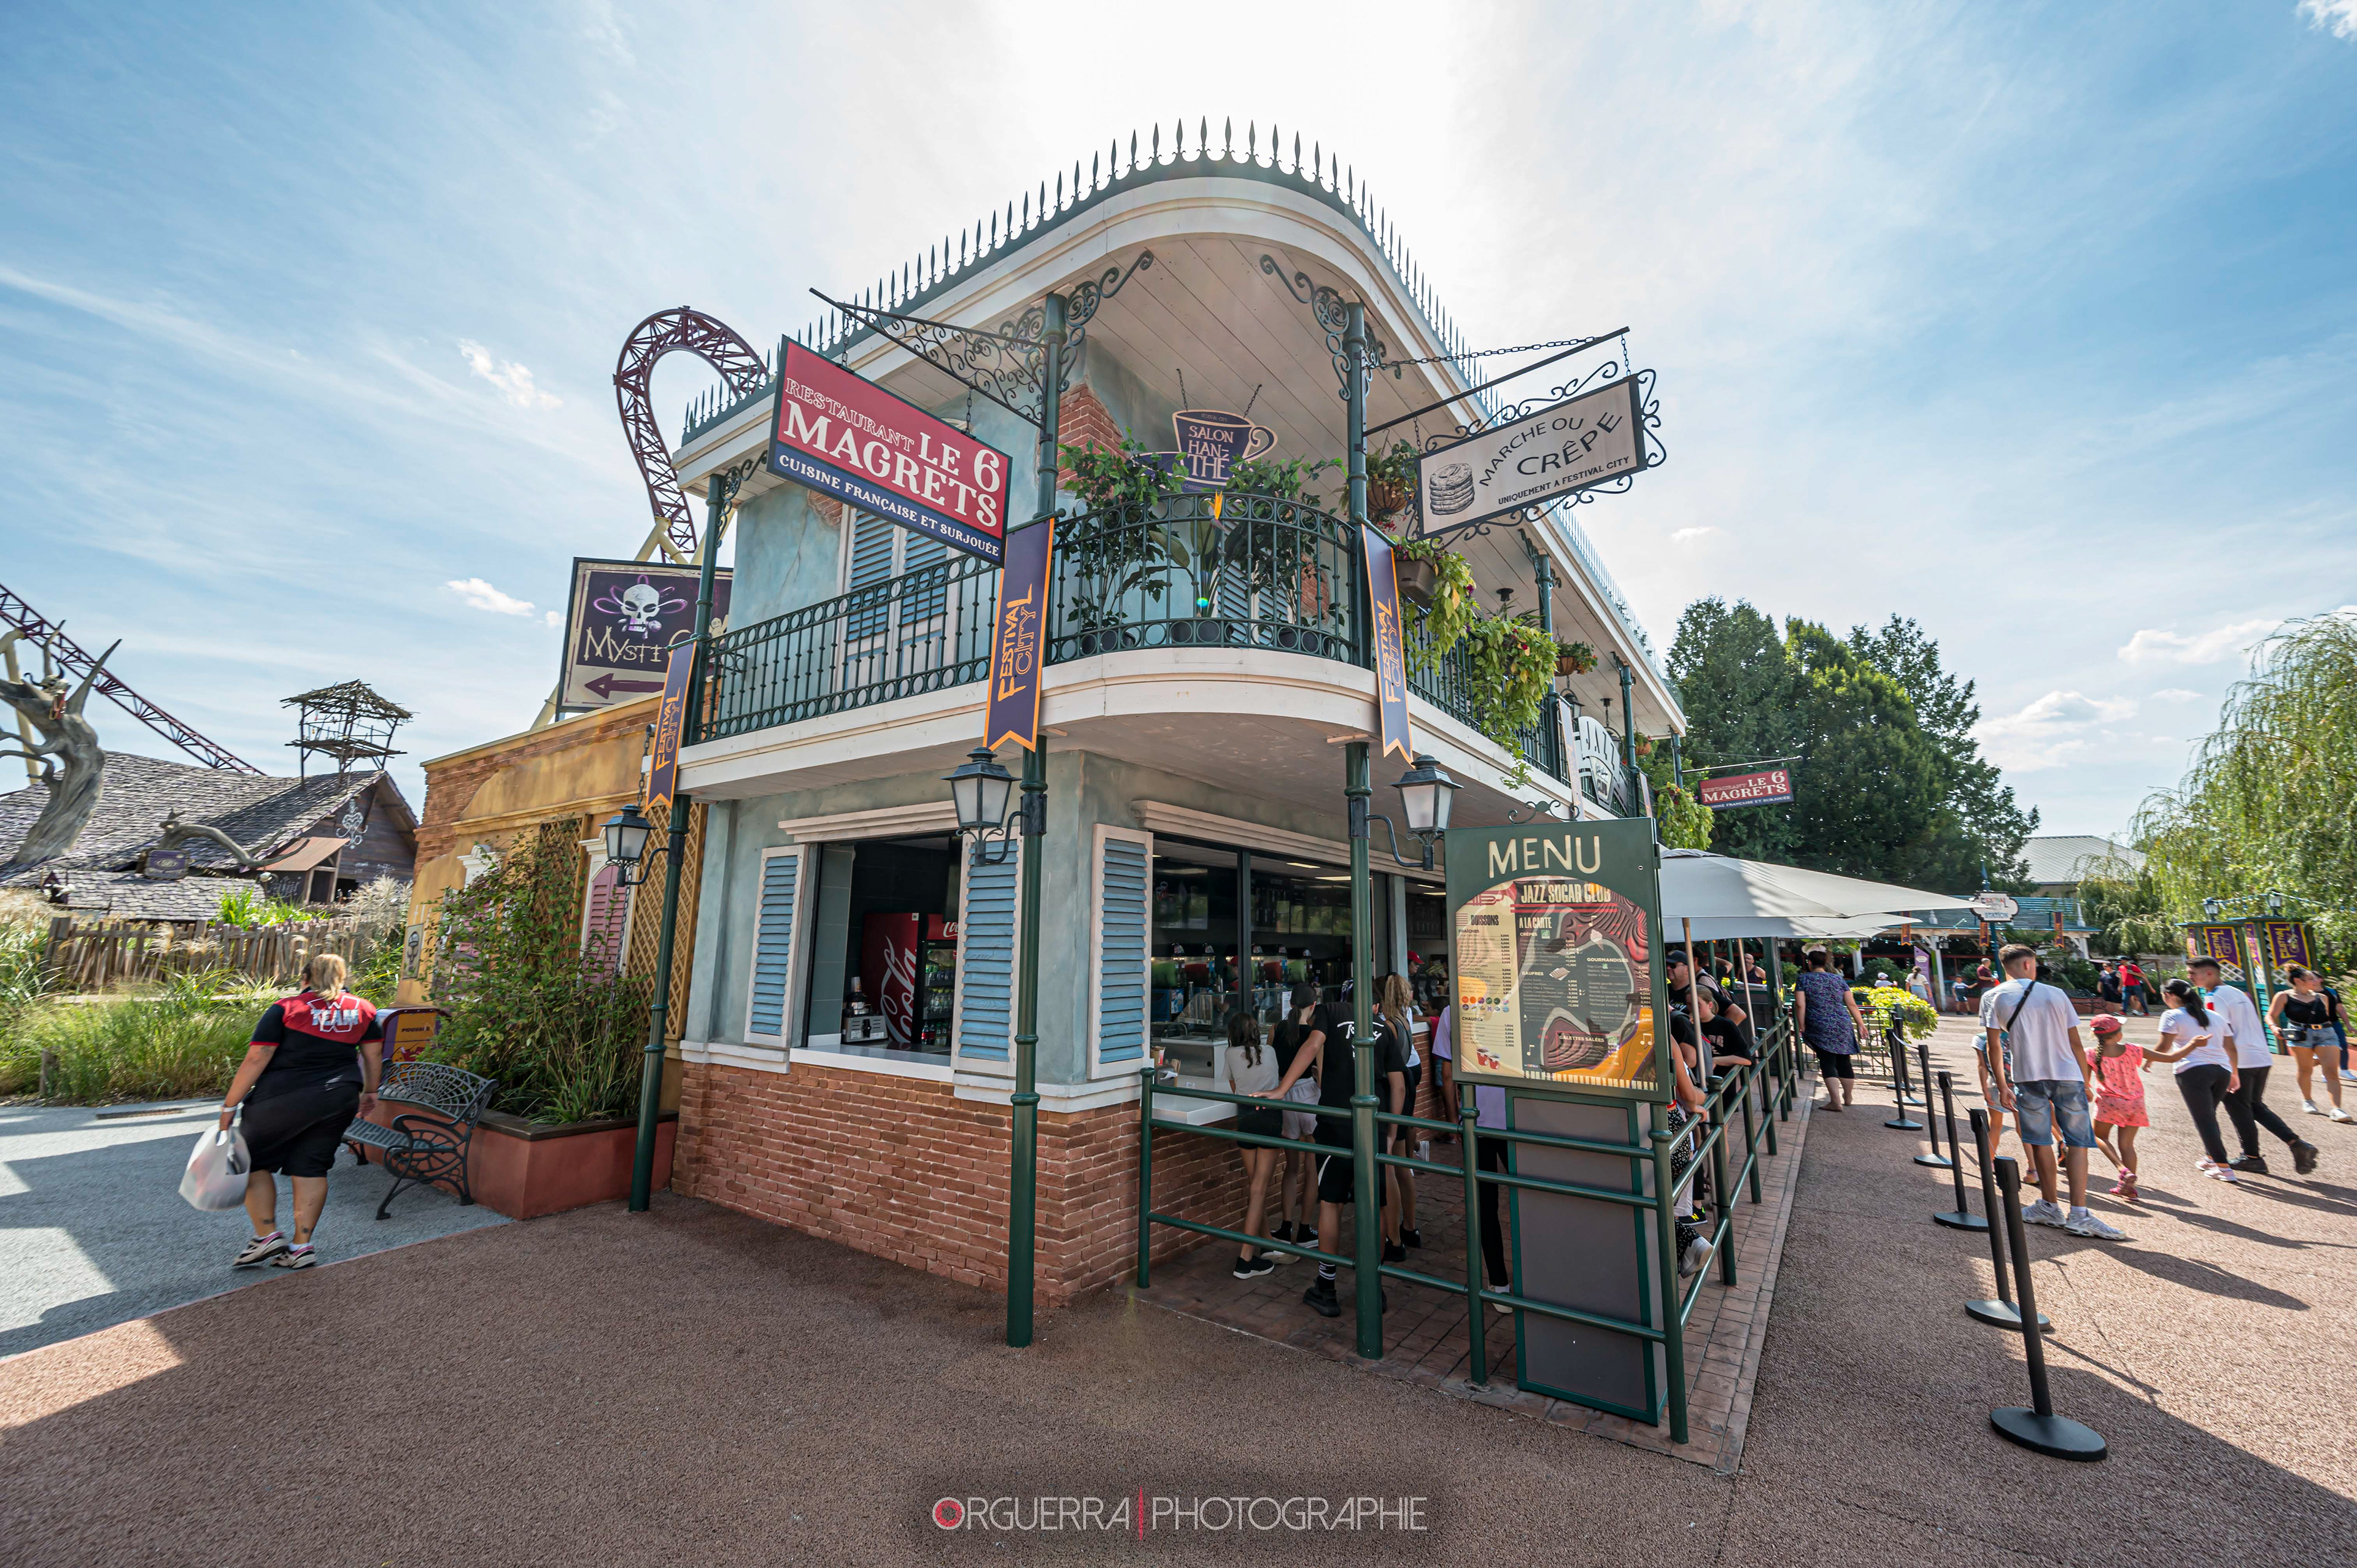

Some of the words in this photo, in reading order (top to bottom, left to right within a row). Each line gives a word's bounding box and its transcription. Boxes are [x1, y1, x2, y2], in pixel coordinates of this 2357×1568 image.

[784, 377, 915, 452] RESTAURANT
[918, 431, 961, 476] LE
[973, 449, 1000, 493] 6
[1188, 425, 1234, 444] SALON
[1479, 422, 1547, 487] MARCHE
[1552, 417, 1584, 431] OU
[1517, 411, 1624, 476] CRÊPE
[783, 400, 997, 528] MAGRETS
[1187, 453, 1230, 481] THÉ
[1498, 482, 1552, 505] UNIQUEMENT
[1554, 479, 1561, 488] A
[1562, 465, 1604, 485] FESTIVAL
[1606, 456, 1630, 469] CITY
[778, 454, 841, 489] CUISINE
[844, 482, 918, 522] FRANÇAISE
[919, 514, 938, 530] ET
[940, 523, 999, 557] SURJOUÉE
[997, 583, 1033, 702] FESTIVAL
[1014, 606, 1036, 675] CITY
[1376, 598, 1401, 704] FESTIVAL
[1387, 620, 1402, 688] CITY
[655, 686, 681, 771] FESTIVAL
[1703, 784, 1787, 803] MAGRETS
[1747, 778, 1767, 787] LE
[1771, 771, 1786, 784] 6
[1488, 835, 1601, 879] MENU
[1520, 884, 1547, 903] JAZZ
[1548, 884, 1582, 903] SUGAR
[1584, 883, 1611, 903] CLUB
[1471, 914, 1499, 925] BOISSONS
[1532, 917, 1552, 929] CARTE
[2274, 925, 2297, 959] FESTIVAL
[2210, 930, 2227, 959] FESTIVAL
[311, 1008, 360, 1026] TEAM
